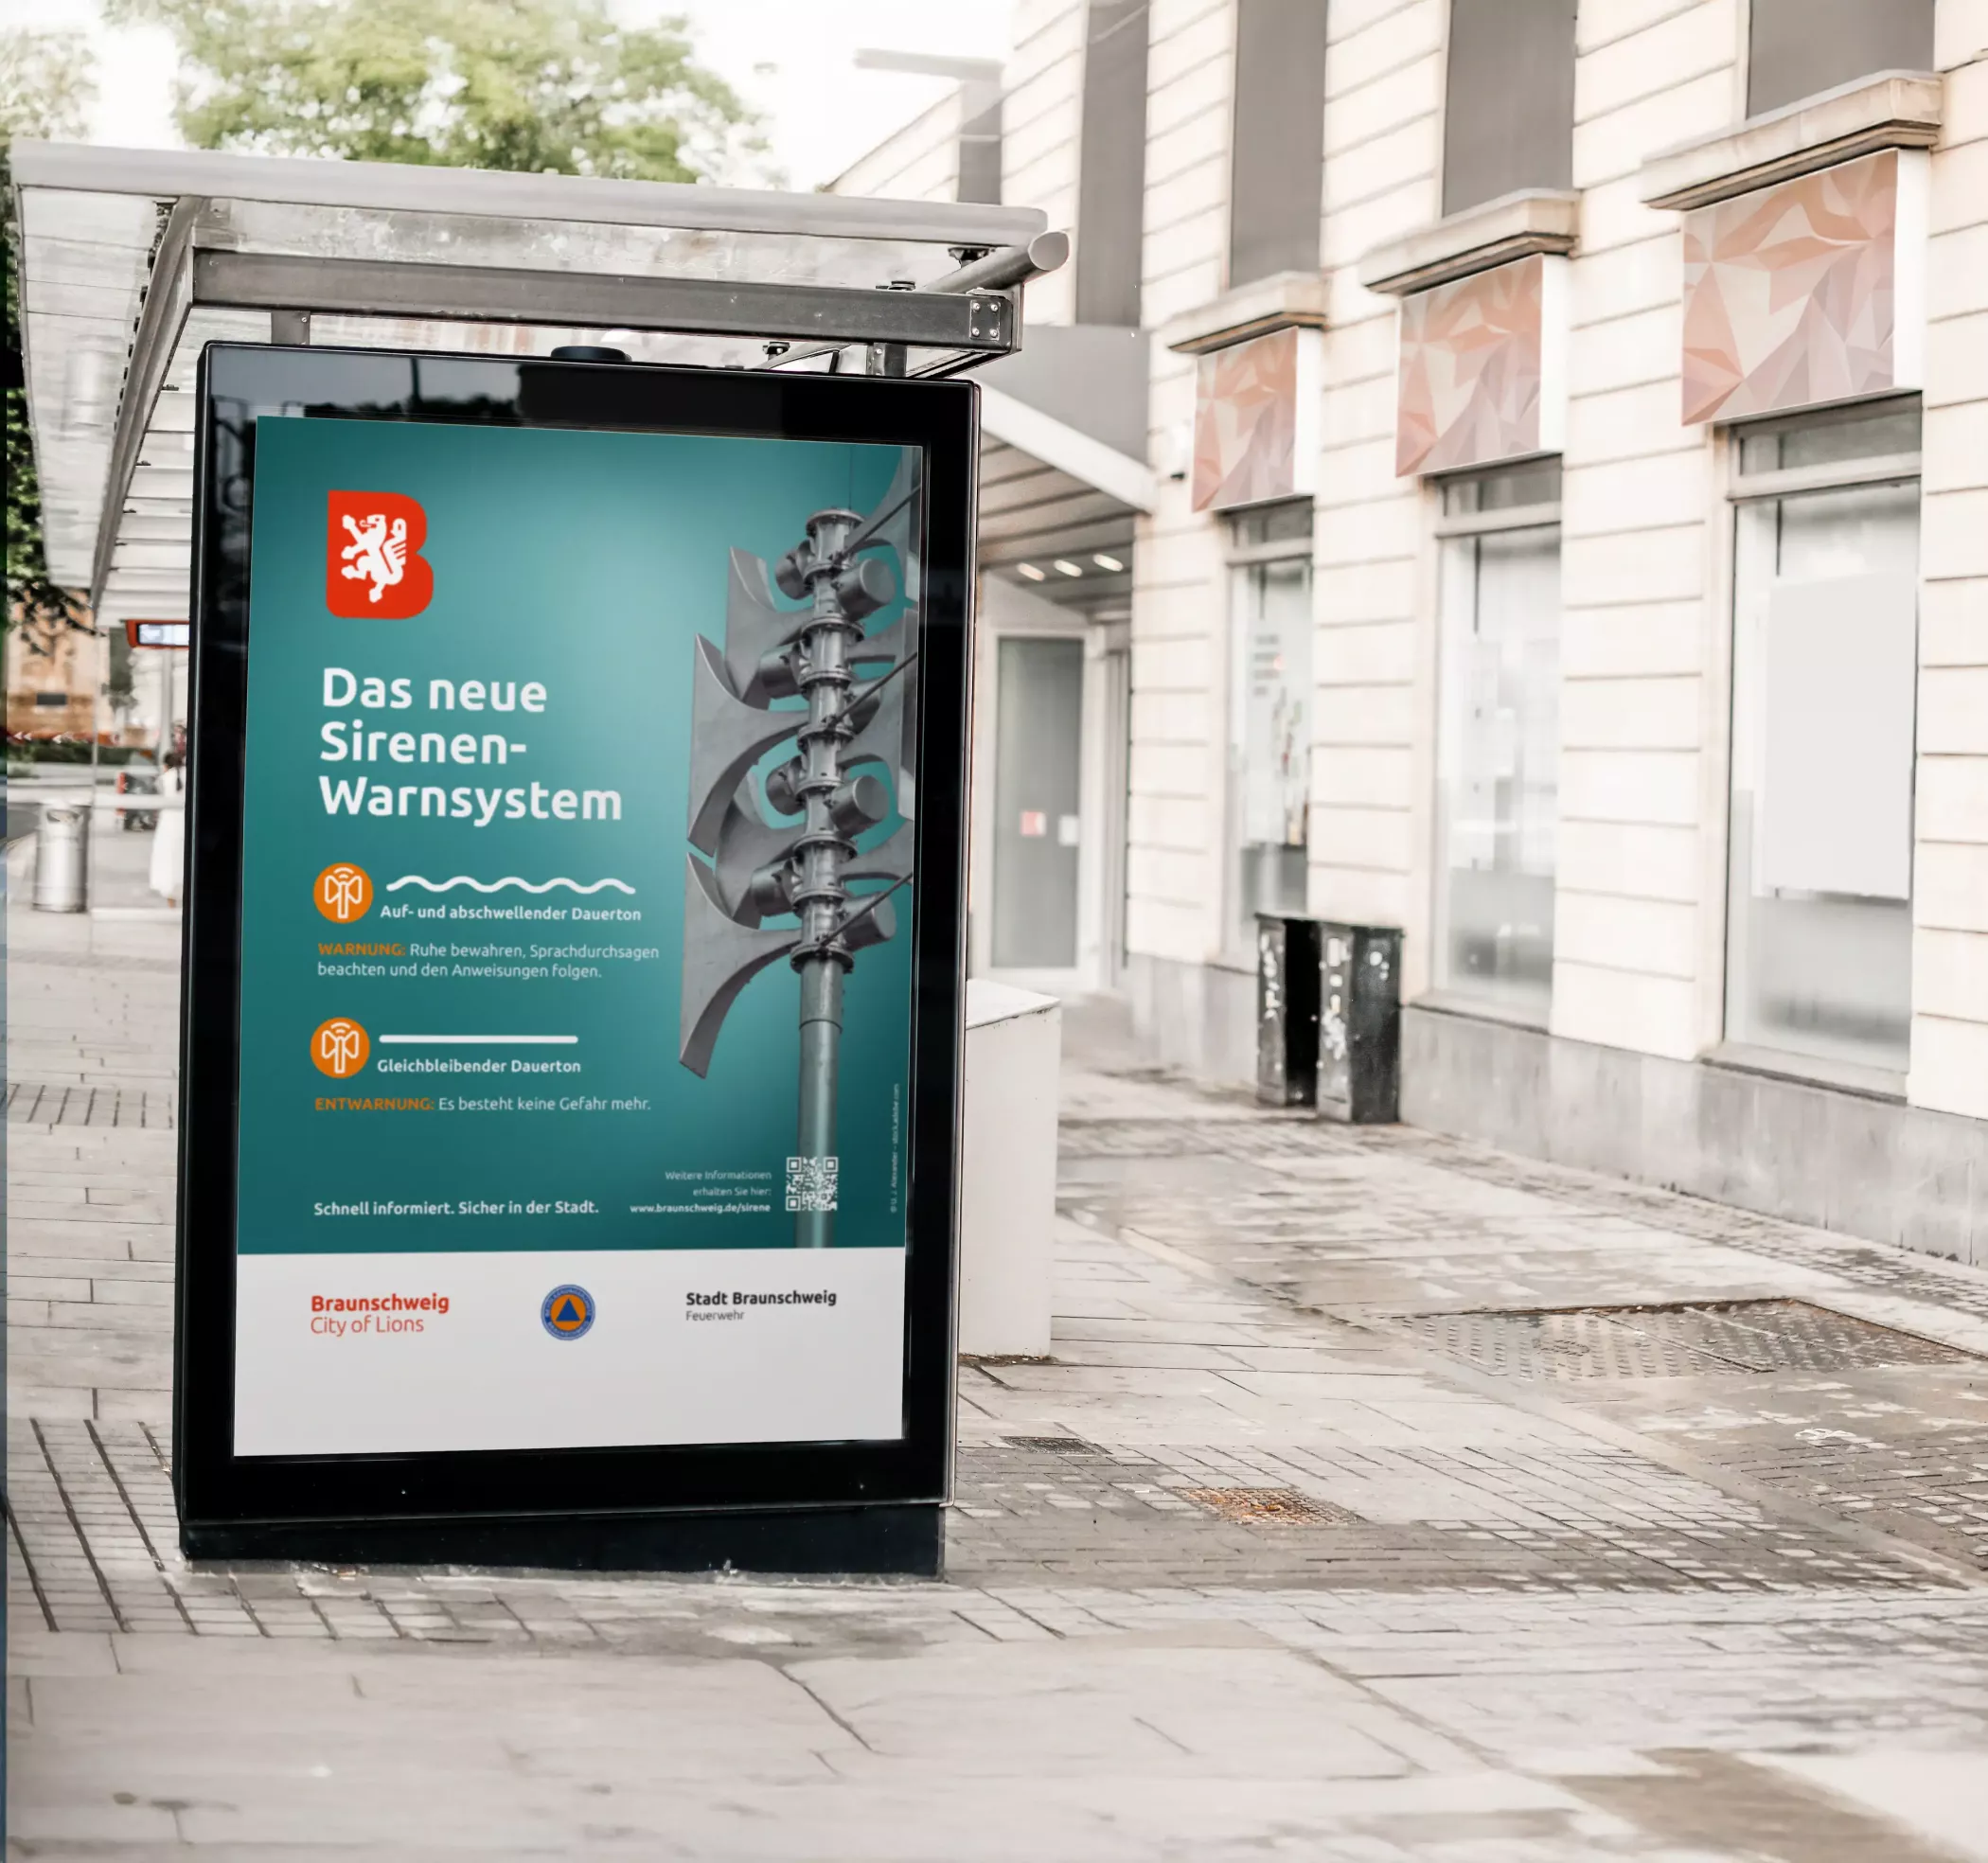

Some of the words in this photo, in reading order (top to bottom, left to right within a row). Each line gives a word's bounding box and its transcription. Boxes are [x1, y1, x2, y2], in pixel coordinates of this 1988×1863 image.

[323, 667, 412, 709] Das
[429, 679, 547, 712] neue
[320, 719, 526, 764] Sirenen-
[319, 775, 621, 826] Warnsystem
[380, 904, 414, 919] Auf-
[417, 905, 445, 919] und
[449, 905, 567, 921] abschwellender
[572, 907, 641, 921] Dauerton
[318, 943, 406, 956] WARNUNG:
[410, 943, 447, 957] Ruhe
[451, 944, 526, 960] bewahren,
[530, 945, 659, 962] Sprachdurchsagen
[317, 961, 385, 976] beachten
[390, 962, 417, 977] und
[420, 962, 448, 977] den
[452, 963, 548, 980] Anweisungen
[552, 963, 602, 980] folgen.
[378, 1058, 506, 1073] Gleichbleibender
[511, 1059, 581, 1073] Dauerton
[315, 1097, 435, 1110] ENTWARNUNG:
[439, 1097, 454, 1110] Es
[458, 1096, 513, 1110] besteht
[518, 1096, 556, 1110] keine
[559, 1096, 607, 1110] Gefahr
[611, 1097, 651, 1110] mehr.
[666, 1170, 702, 1180] Weitere
[704, 1170, 772, 1180] Informationen
[693, 1186, 732, 1197] erhalten
[735, 1186, 749, 1196] Sie
[751, 1186, 772, 1196] hier:
[313, 1201, 369, 1215] Schnell
[373, 1200, 454, 1215] informiert.
[458, 1200, 505, 1215] Sicher
[508, 1200, 522, 1214] in
[525, 1199, 551, 1214] der
[555, 1199, 599, 1214] Stadt.
[630, 1202, 771, 1214] www.braunschweig.de/sirene
[311, 1292, 450, 1314] Braunschweig
[686, 1291, 727, 1305] Stadt
[733, 1289, 837, 1306] Braunschweig
[686, 1310, 744, 1322] Feuerwehr
[311, 1315, 346, 1337] City
[350, 1315, 371, 1334] of
[376, 1316, 424, 1334] Lions
